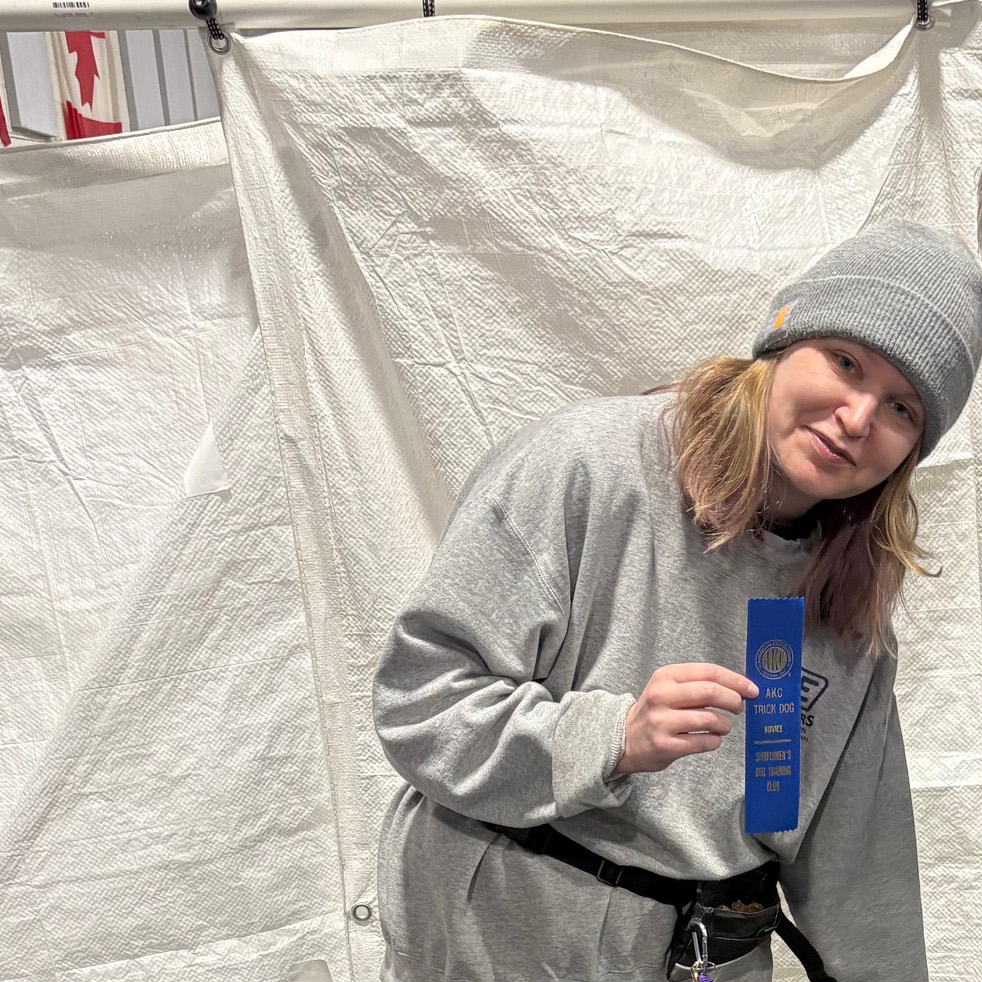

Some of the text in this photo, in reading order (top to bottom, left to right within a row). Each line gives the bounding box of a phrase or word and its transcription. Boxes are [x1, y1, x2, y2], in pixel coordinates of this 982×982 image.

[765, 687, 783, 698] AKC
[754, 702, 795, 715] TRICK DOG
